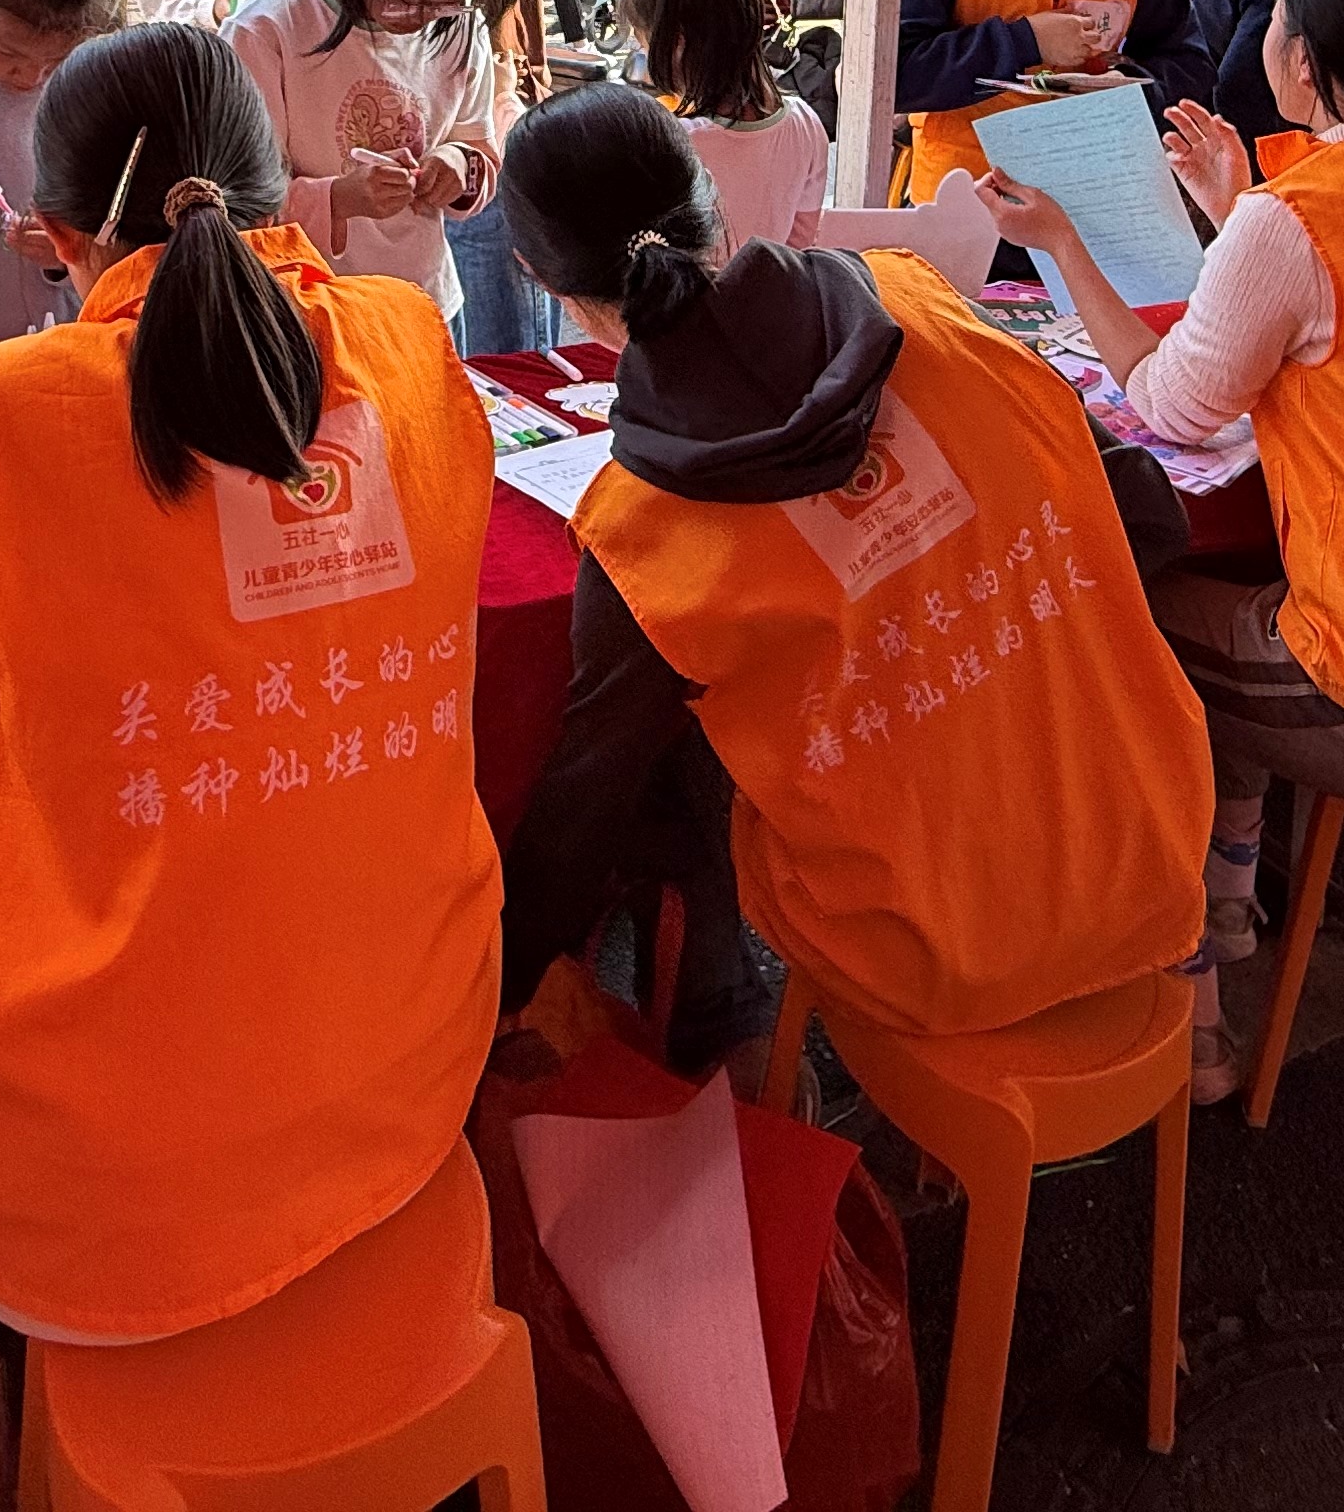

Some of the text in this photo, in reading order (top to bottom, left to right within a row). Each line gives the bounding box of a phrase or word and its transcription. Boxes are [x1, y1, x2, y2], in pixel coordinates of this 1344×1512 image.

[242, 540, 398, 590] 儿童青少年安心驿站
